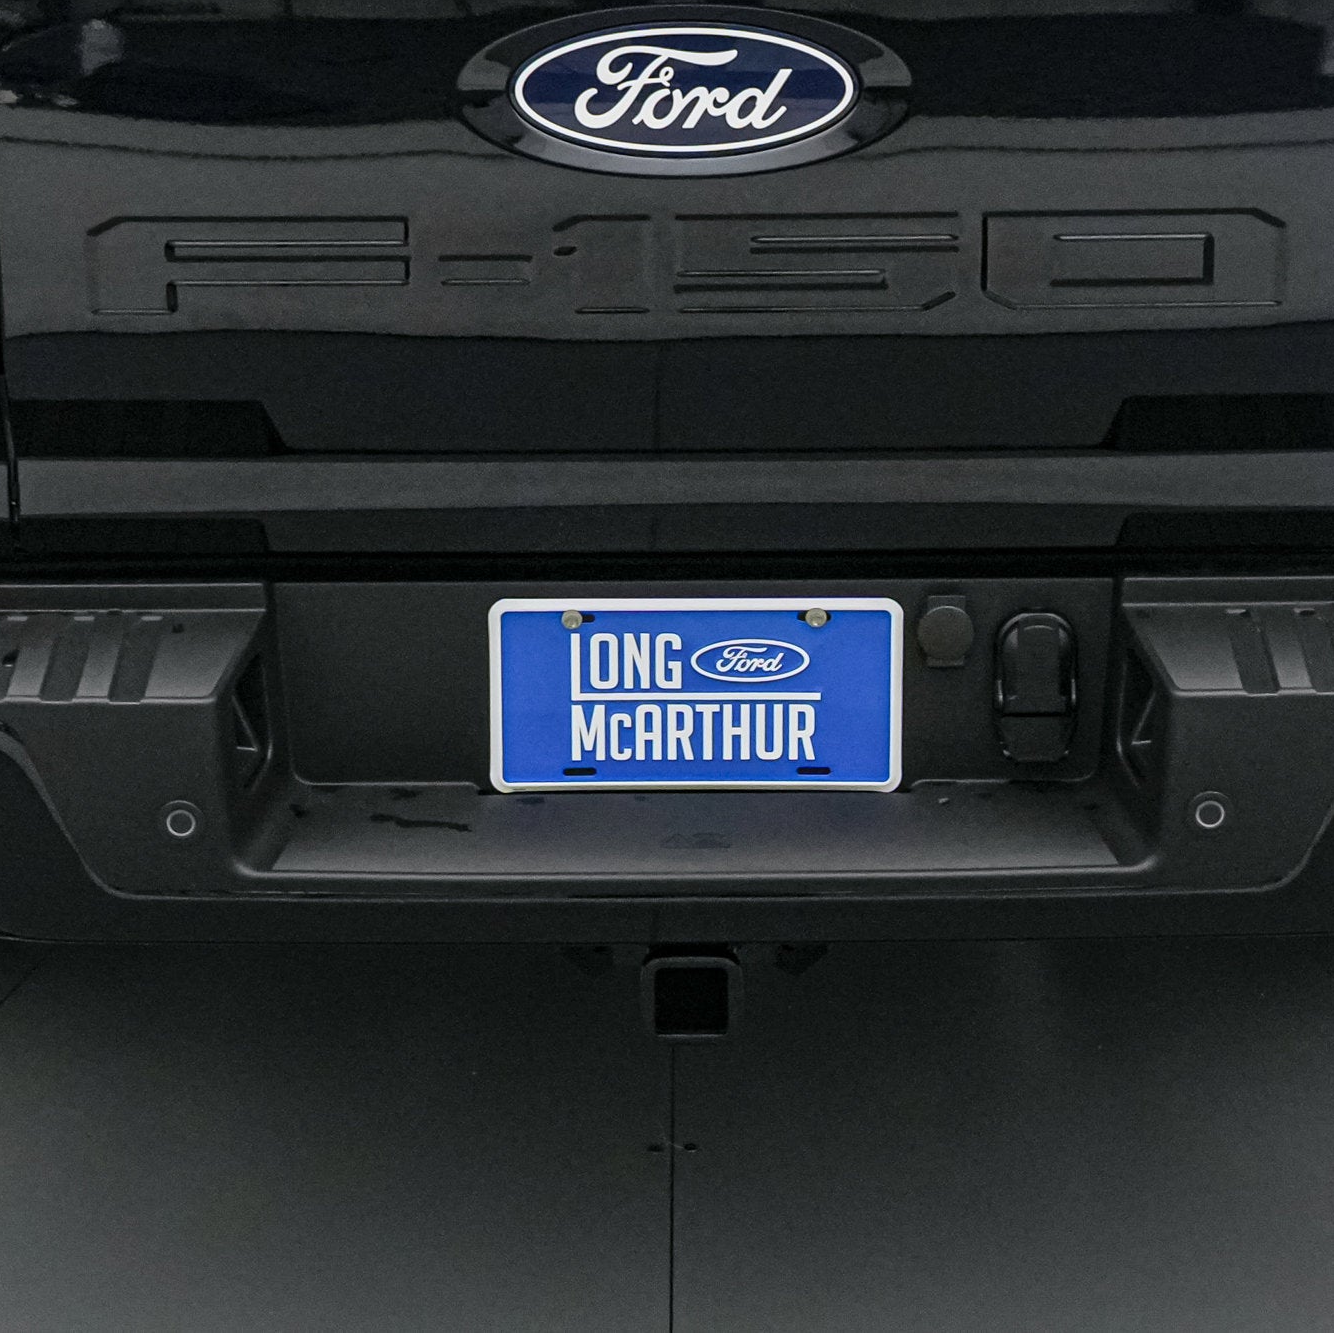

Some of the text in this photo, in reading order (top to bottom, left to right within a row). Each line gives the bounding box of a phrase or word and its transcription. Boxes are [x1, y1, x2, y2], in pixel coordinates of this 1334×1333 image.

[574, 45, 793, 129] Ford
[86, 208, 1288, 315] F-150
[570, 632, 784, 699] LONG Ford
[571, 704, 816, 761] McARTHUR
